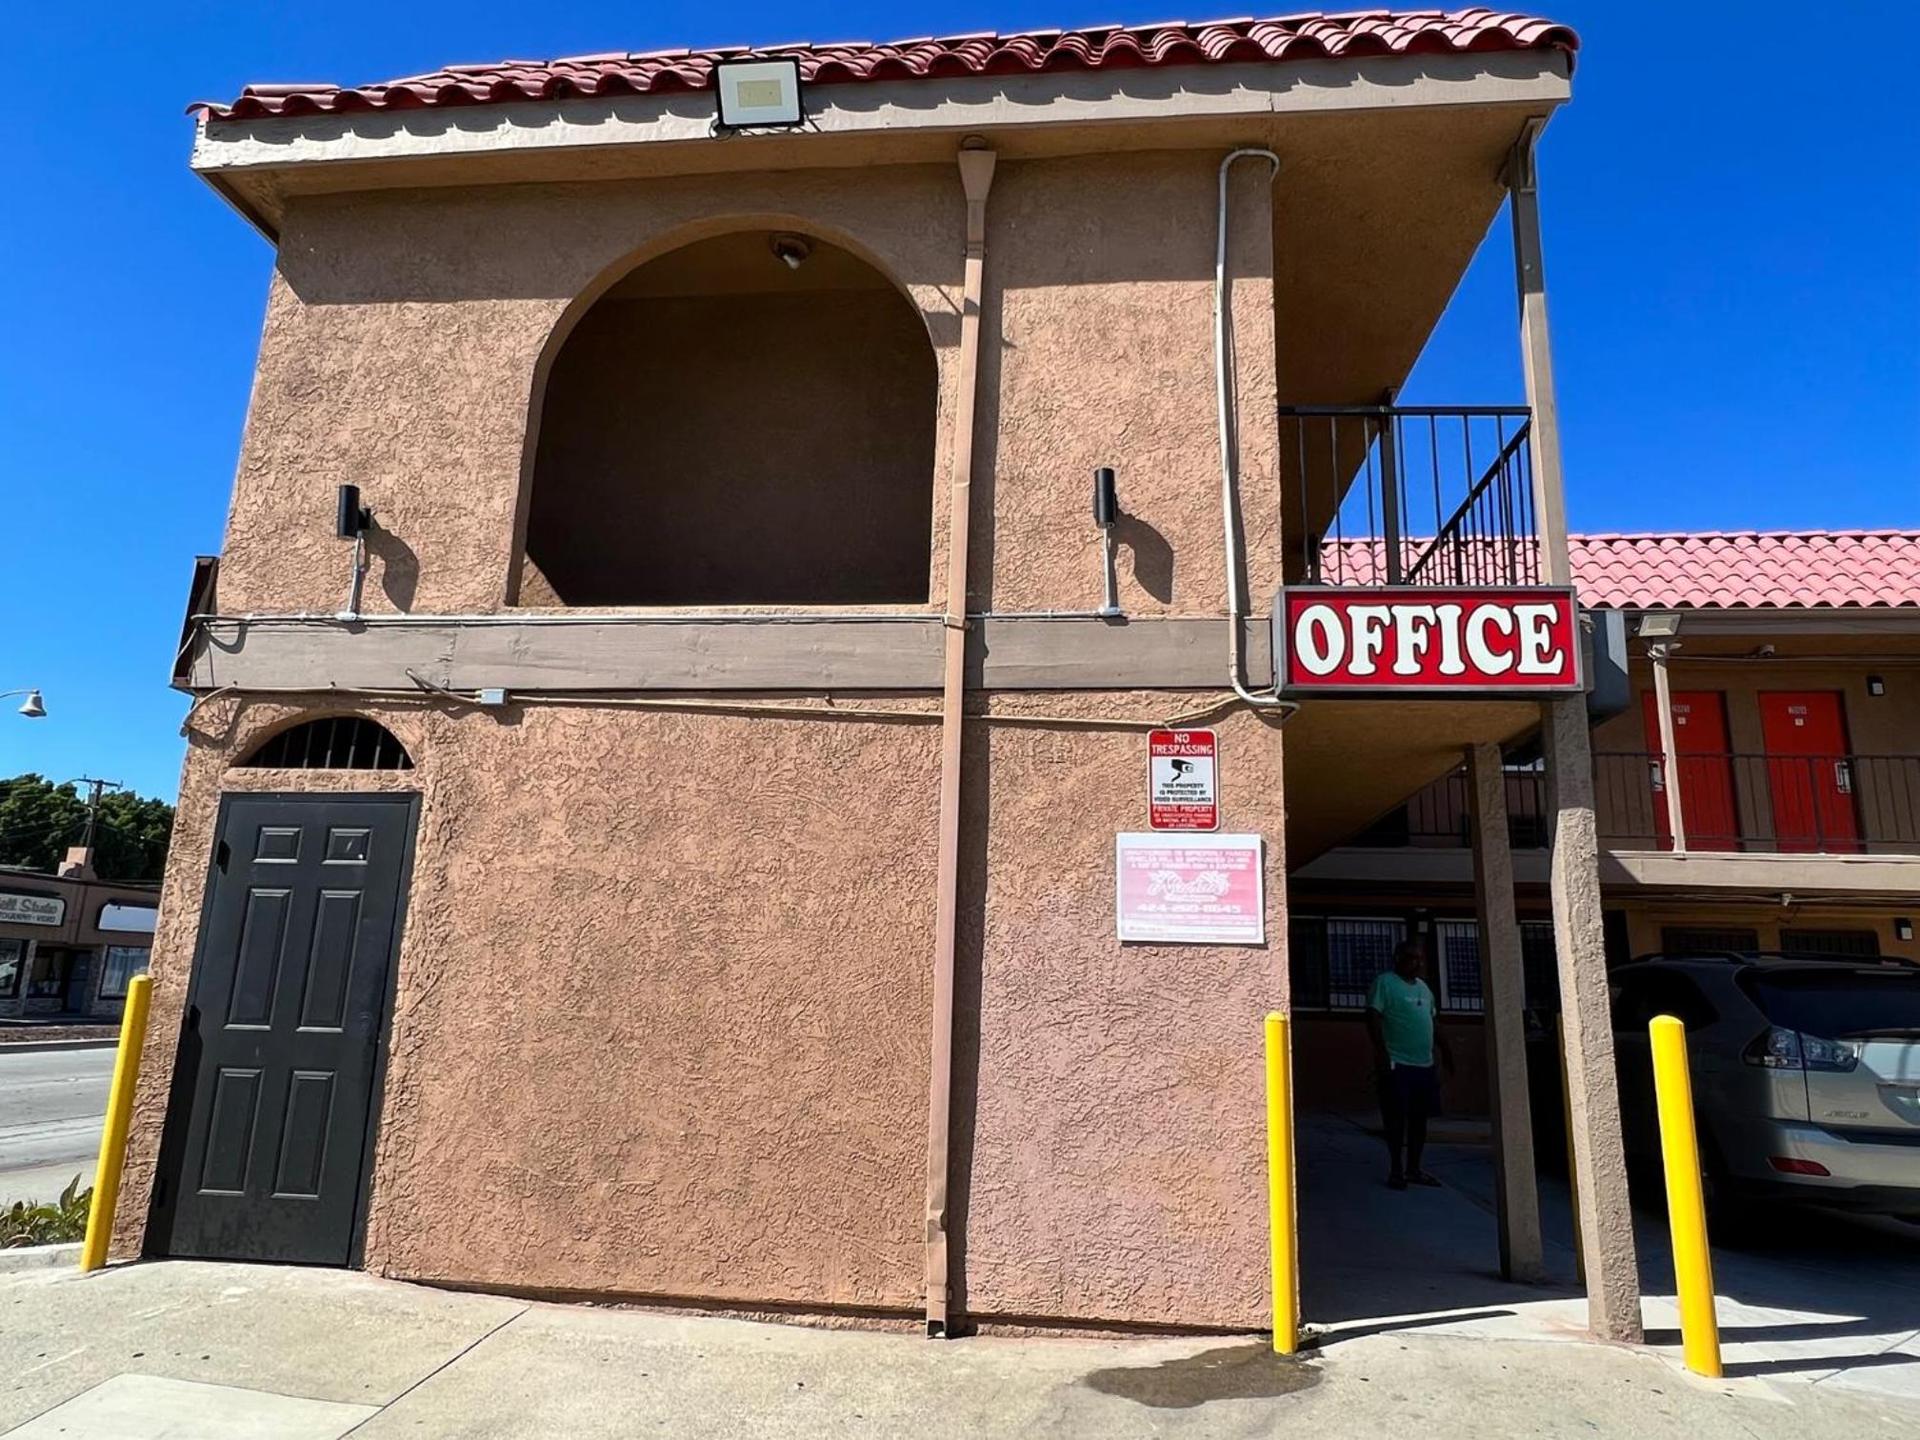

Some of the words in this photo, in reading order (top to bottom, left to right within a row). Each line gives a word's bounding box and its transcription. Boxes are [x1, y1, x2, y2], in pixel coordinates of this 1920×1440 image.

[1294, 603, 1564, 676] OFFICE
[1174, 733, 1190, 744] NO
[1151, 744, 1213, 755] TRESPASSING
